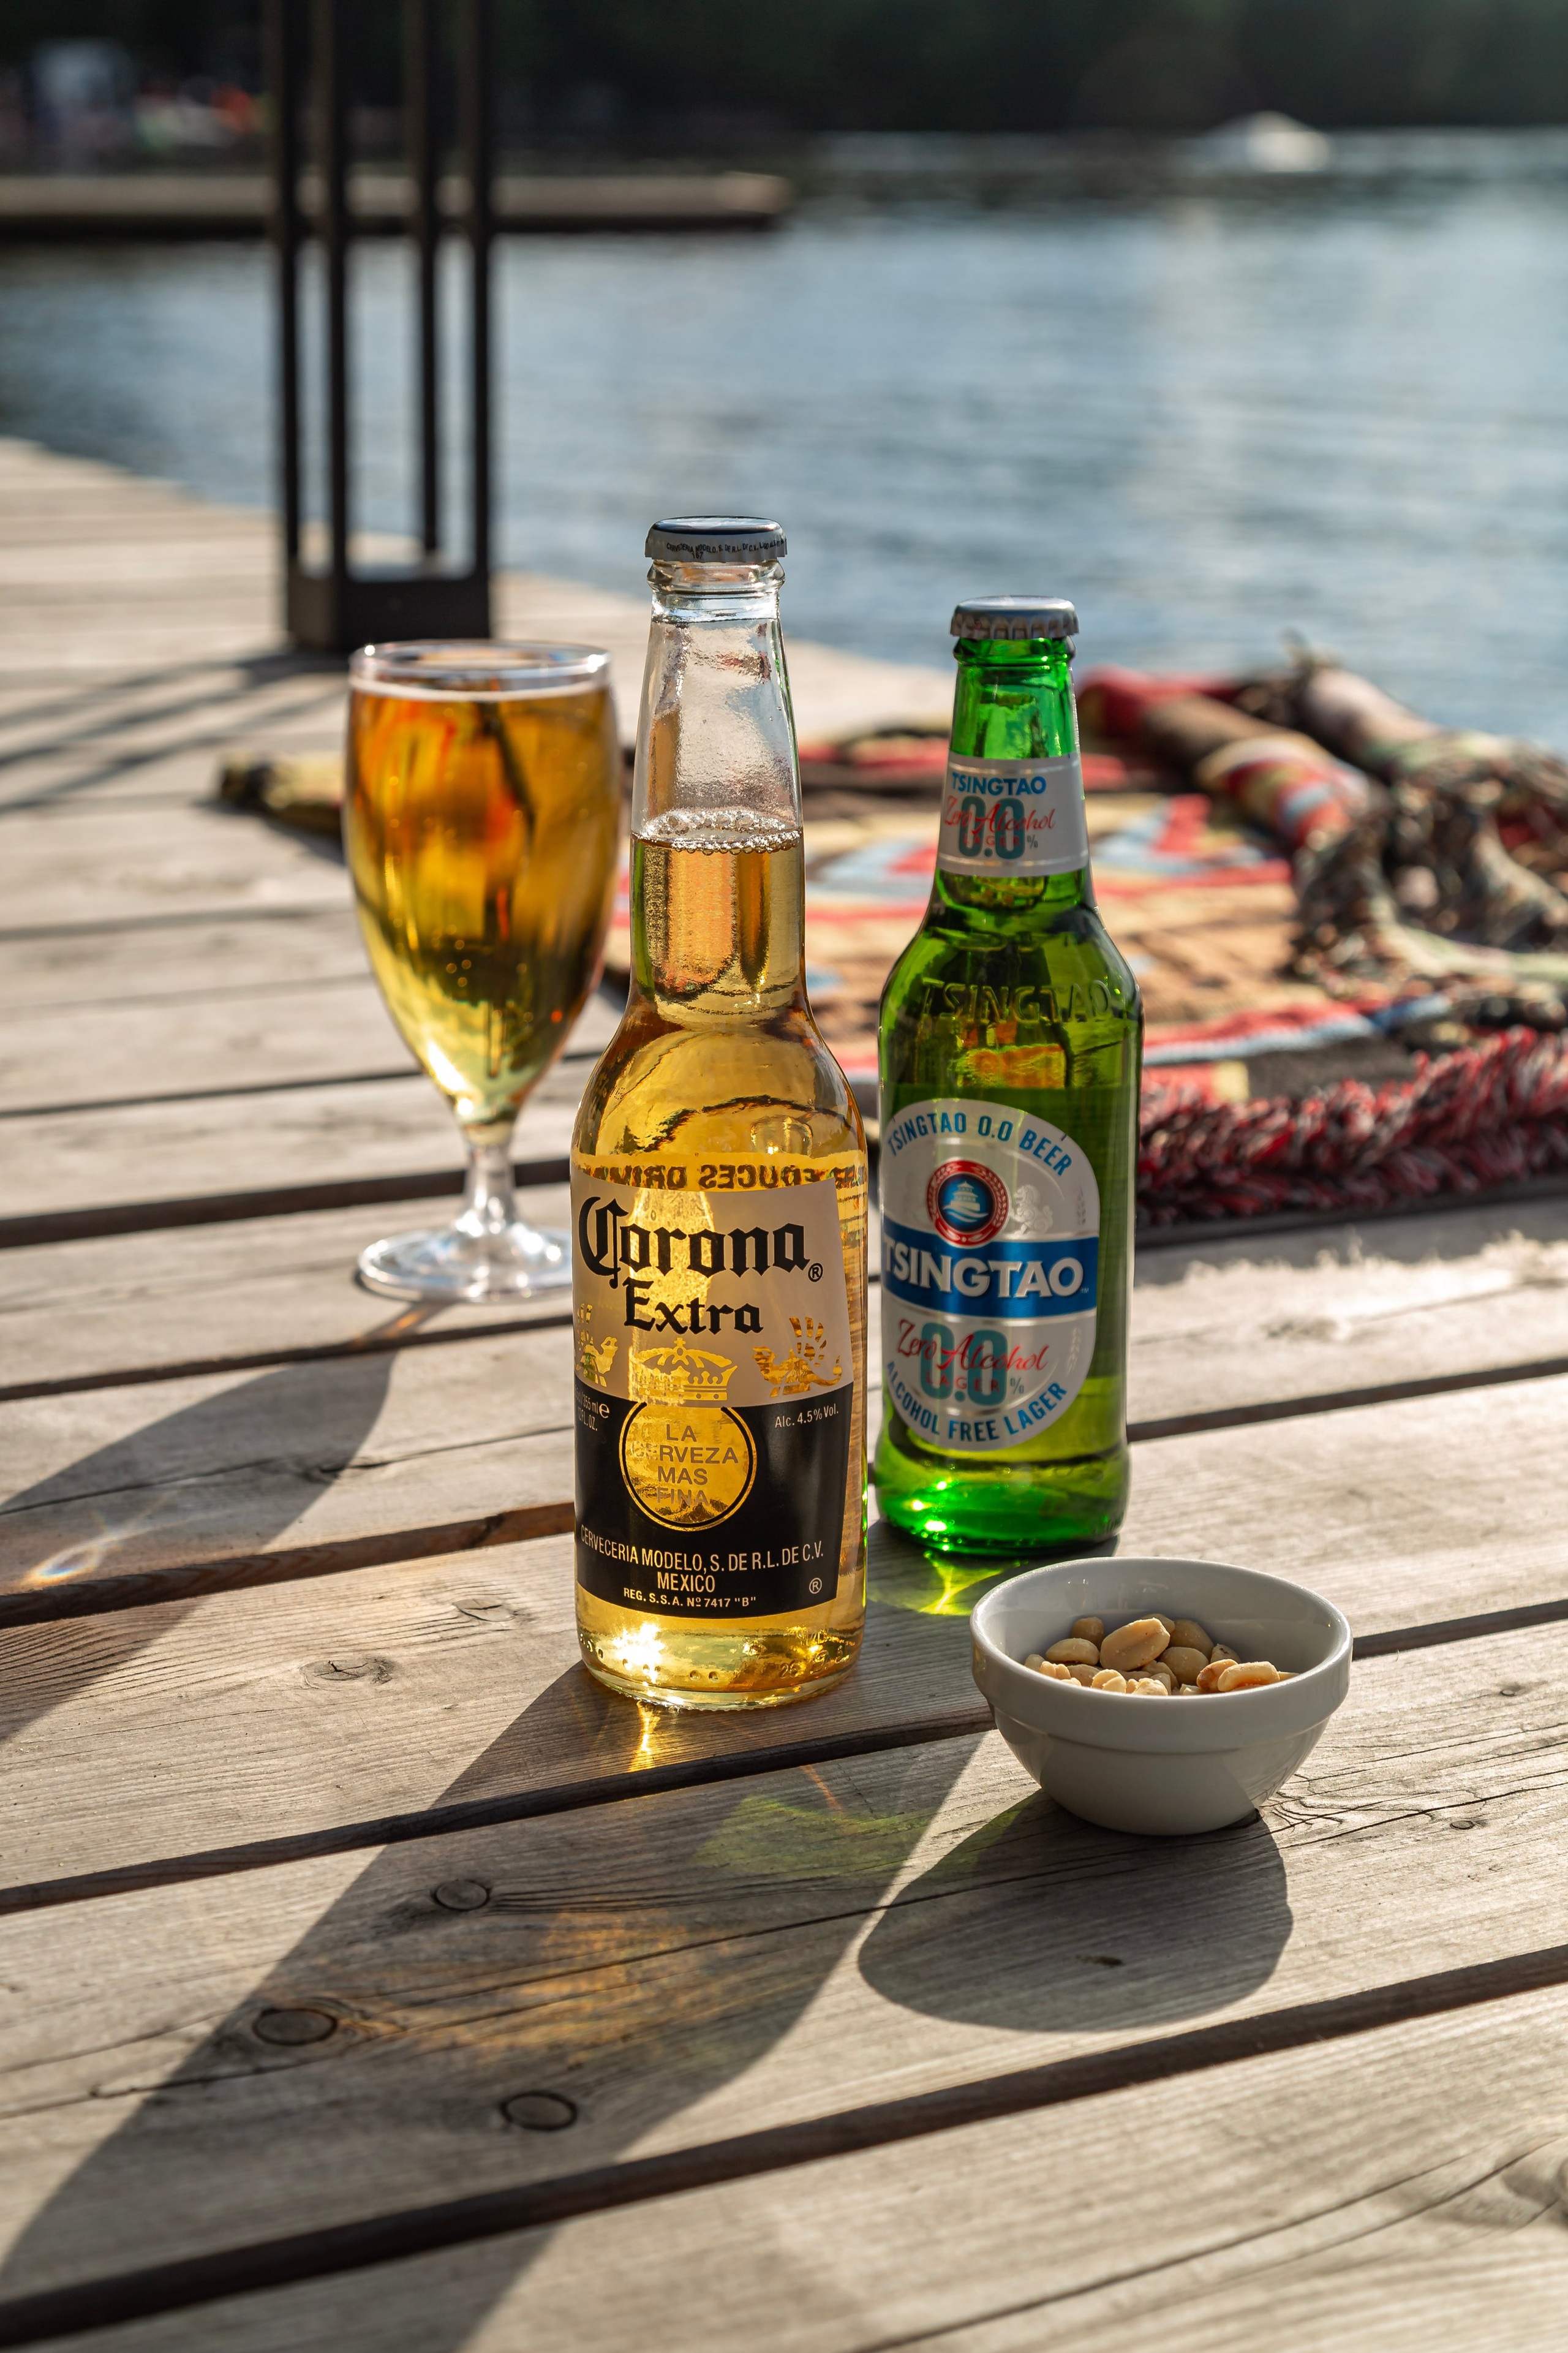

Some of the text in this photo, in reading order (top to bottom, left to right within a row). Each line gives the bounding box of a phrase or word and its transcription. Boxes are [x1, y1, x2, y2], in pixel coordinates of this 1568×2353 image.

[952, 772, 1047, 796] TSINGTAO
[922, 978, 1111, 1024] TSINGTAO
[888, 1112, 967, 1157] TSINGTAO
[1019, 1128, 1072, 1177] BEER
[578, 1196, 810, 1290] Corona
[883, 1233, 1084, 1299] TSINGTAO
[622, 1277, 764, 1335] Extra
[898, 1319, 1050, 1371] Zero Alcohol
[926, 1372, 1001, 1393] LAGER
[887, 1361, 1067, 1442] ALCOHOL FREE LAGER
[666, 1424, 697, 1442] LA
[775, 1415, 795, 1428] Alc.
[630, 1441, 739, 1464] CERVEZA
[658, 1465, 708, 1486] MAS
[657, 1487, 709, 1506] FINA
[581, 1524, 823, 1574] CERVECERIA MODELO, S. DE R.L. DE C.V.
[657, 1571, 715, 1593] MEXICO
[624, 1587, 646, 1602] REG.
[704, 1598, 731, 1607] 7417
